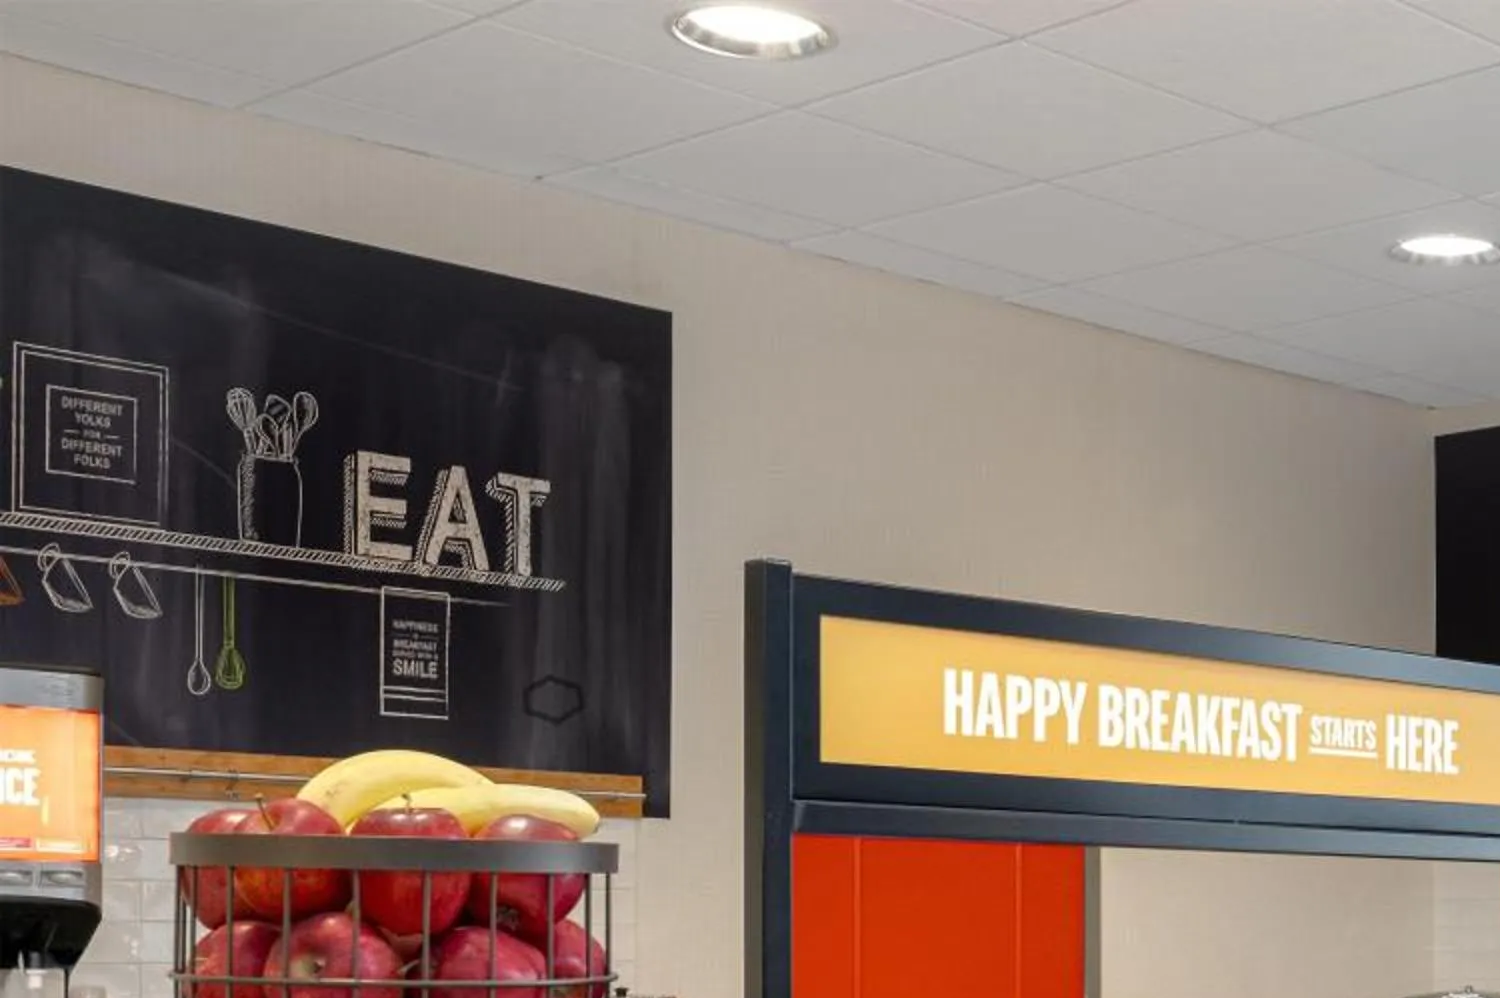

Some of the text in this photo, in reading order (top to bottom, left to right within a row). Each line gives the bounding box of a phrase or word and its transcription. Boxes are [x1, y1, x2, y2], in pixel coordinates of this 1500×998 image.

[343, 450, 551, 577] EAT
[392, 657, 439, 679] SMILE
[943, 668, 1459, 774] HAPPY BREAKFAST STARTS HERE
